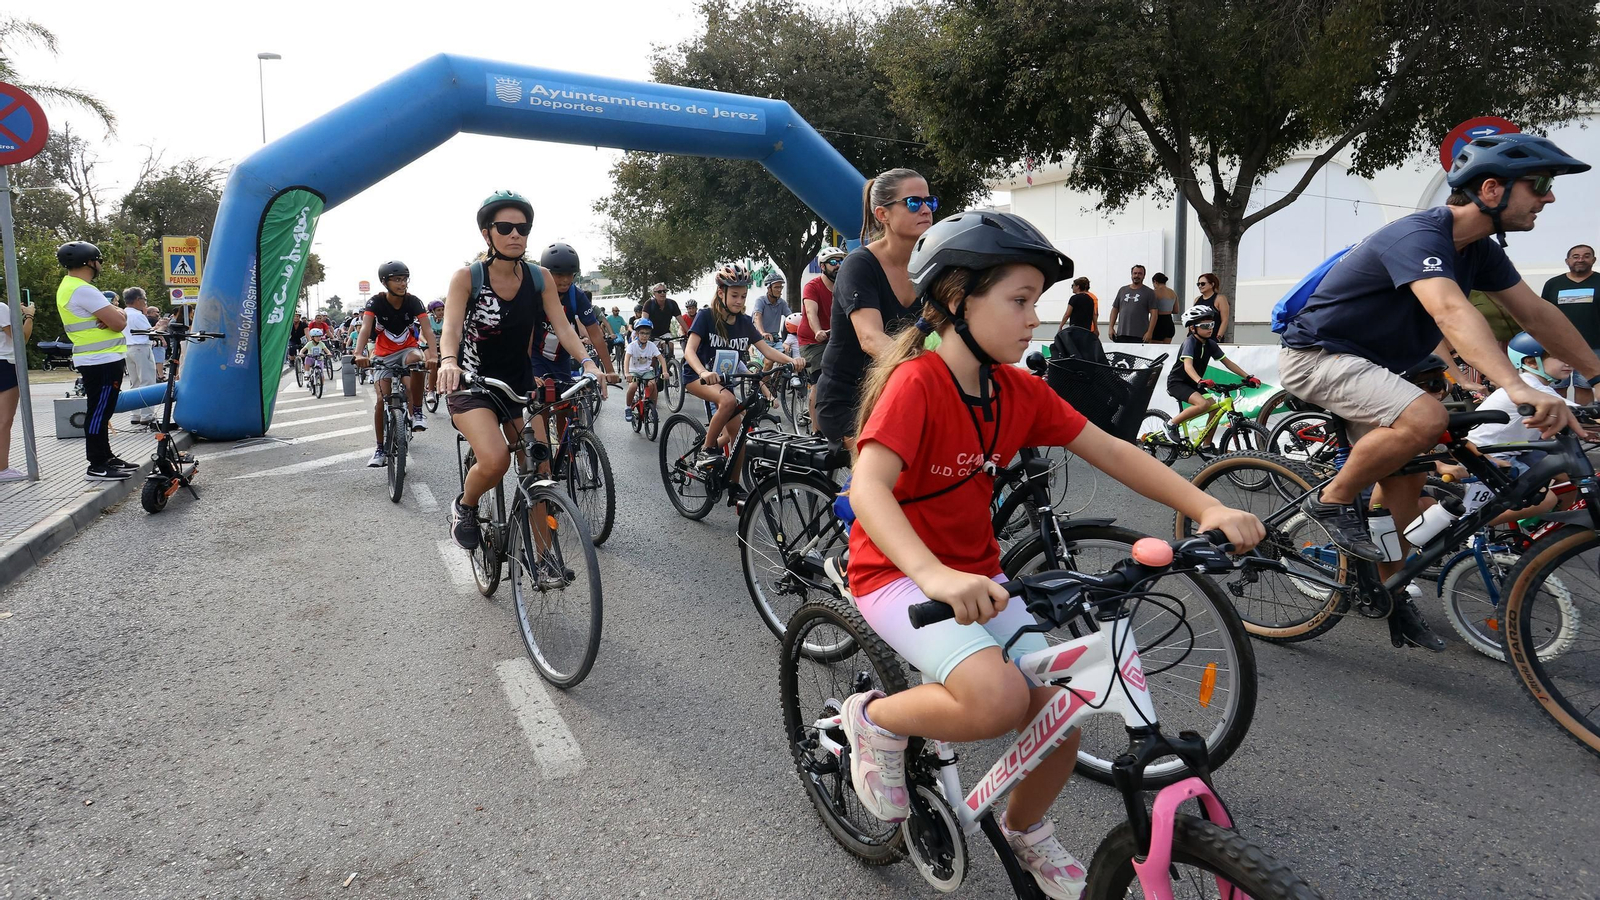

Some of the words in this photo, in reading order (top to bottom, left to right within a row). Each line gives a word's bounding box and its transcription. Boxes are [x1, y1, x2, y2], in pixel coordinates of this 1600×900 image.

[530, 84, 680, 112] Ayuntamiento
[686, 104, 708, 115] de
[713, 107, 758, 121] Jerez
[530, 97, 603, 113] Deportes
[930, 464, 954, 477] U.D.
[1508, 609, 1526, 664] BARZO
